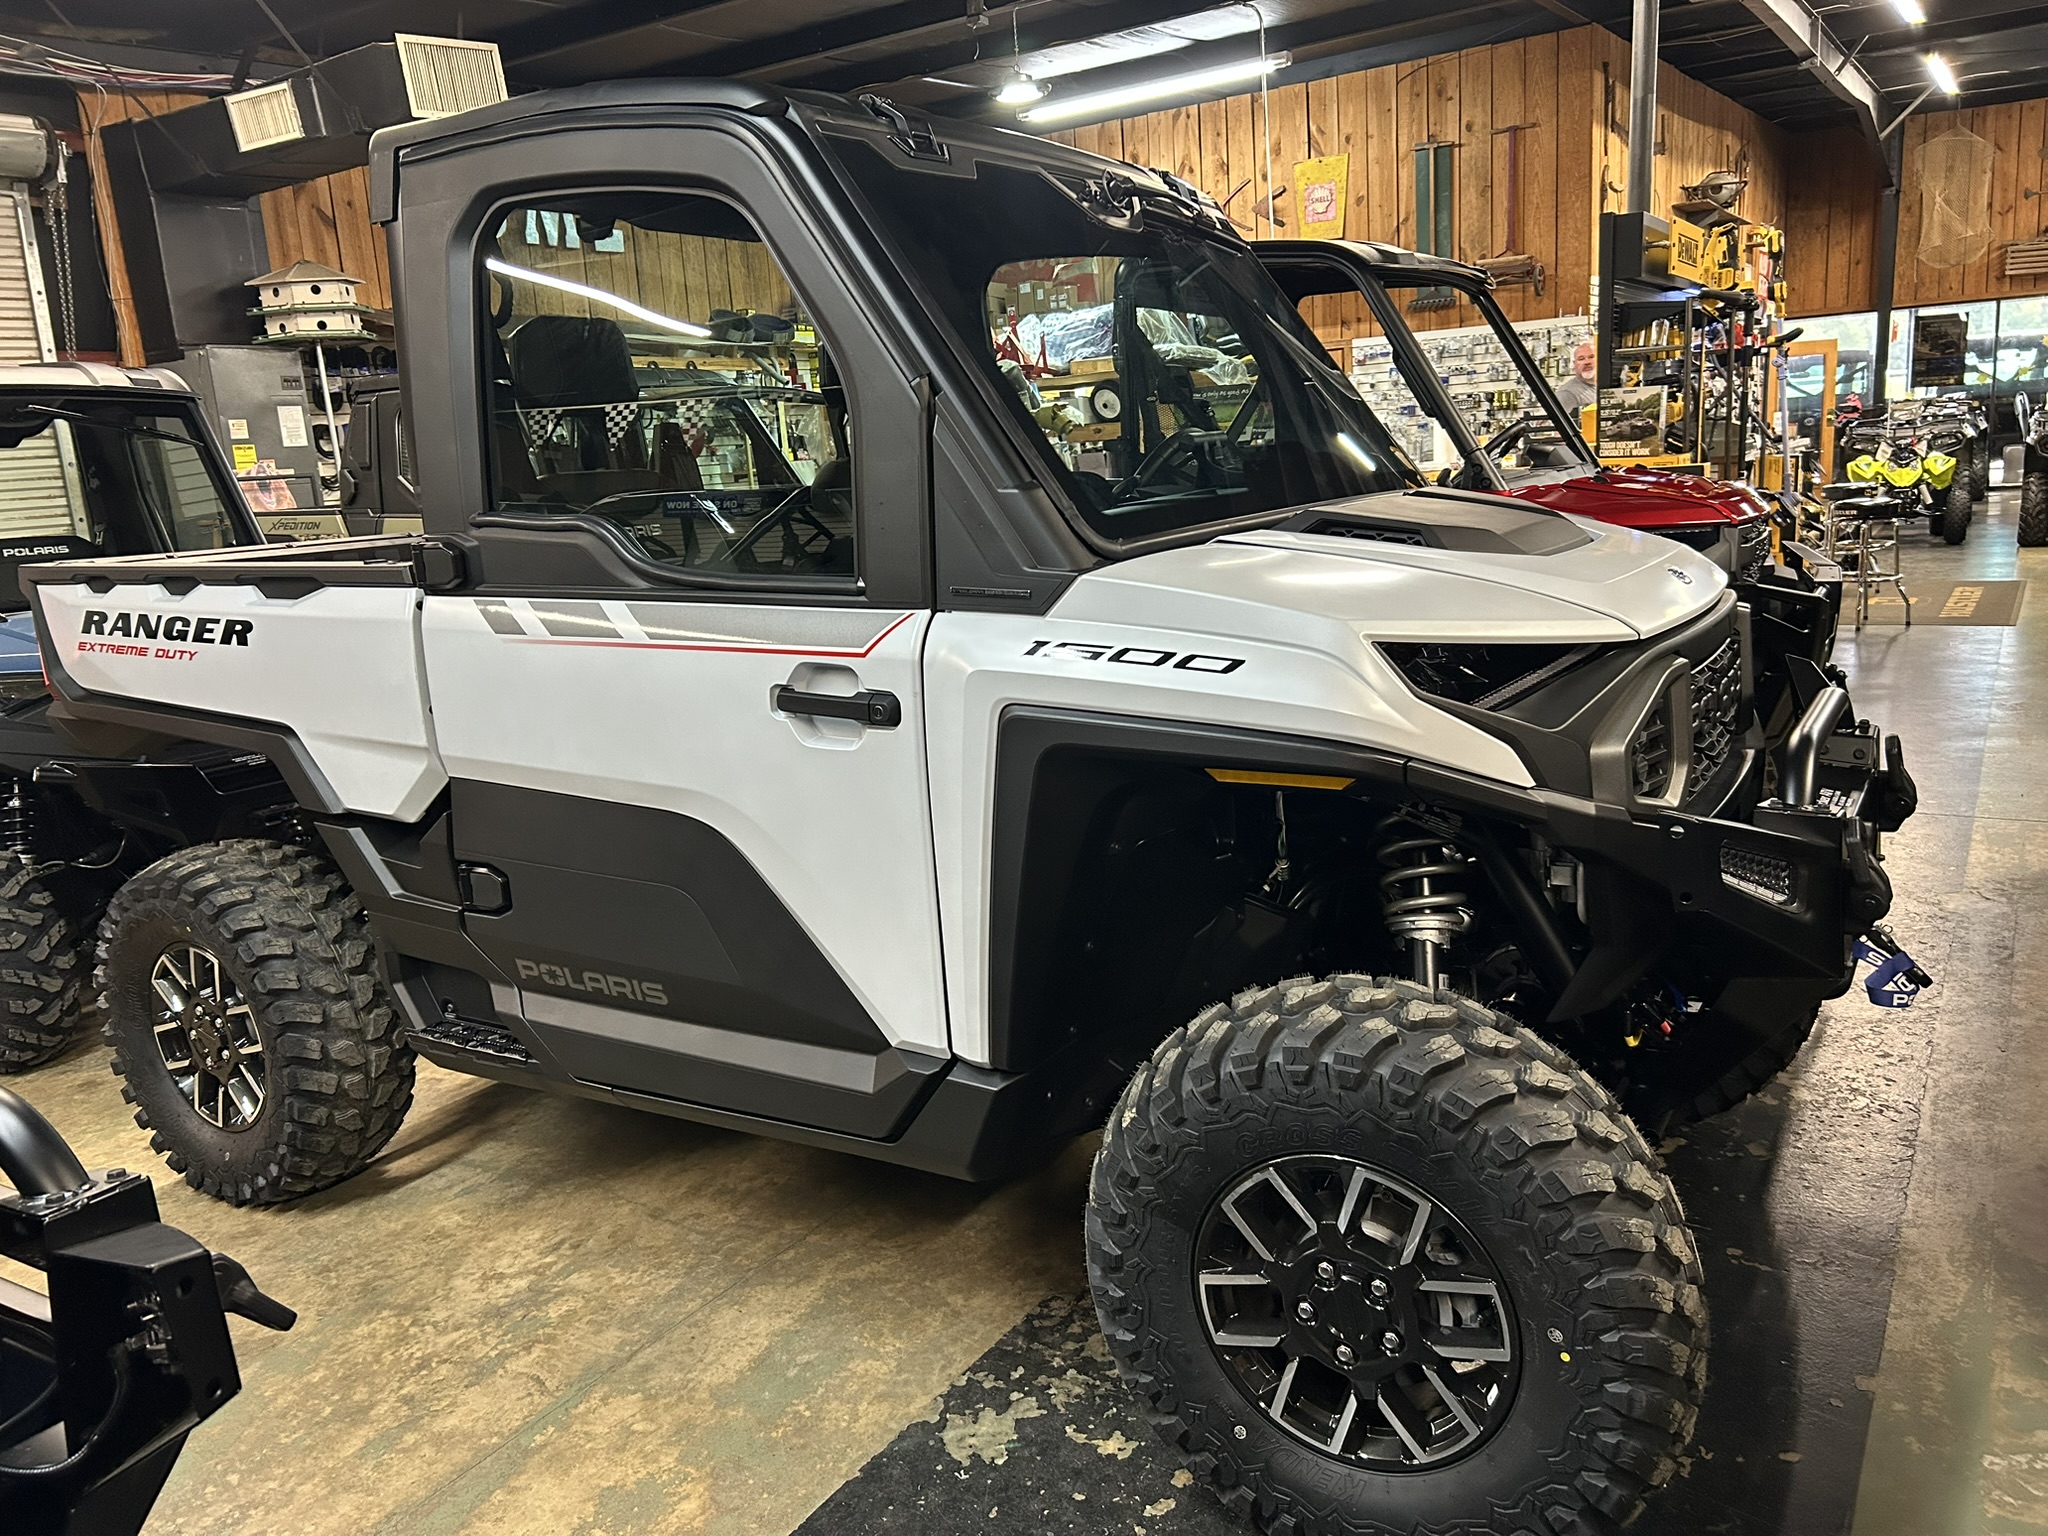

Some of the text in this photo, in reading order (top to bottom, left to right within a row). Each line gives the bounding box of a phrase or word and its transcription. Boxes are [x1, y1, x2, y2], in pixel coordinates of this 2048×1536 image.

[1310, 195, 1330, 204] SHELL
[268, 518, 321, 532] XPEDITION
[3, 545, 70, 557] POLARIS
[80, 609, 254, 647] RANGER
[77, 641, 199, 661] EXTREME DUTY
[1023, 640, 1246, 675] 1500
[514, 957, 669, 1006] POLARIS
[1235, 1121, 1363, 1160] CROSS
